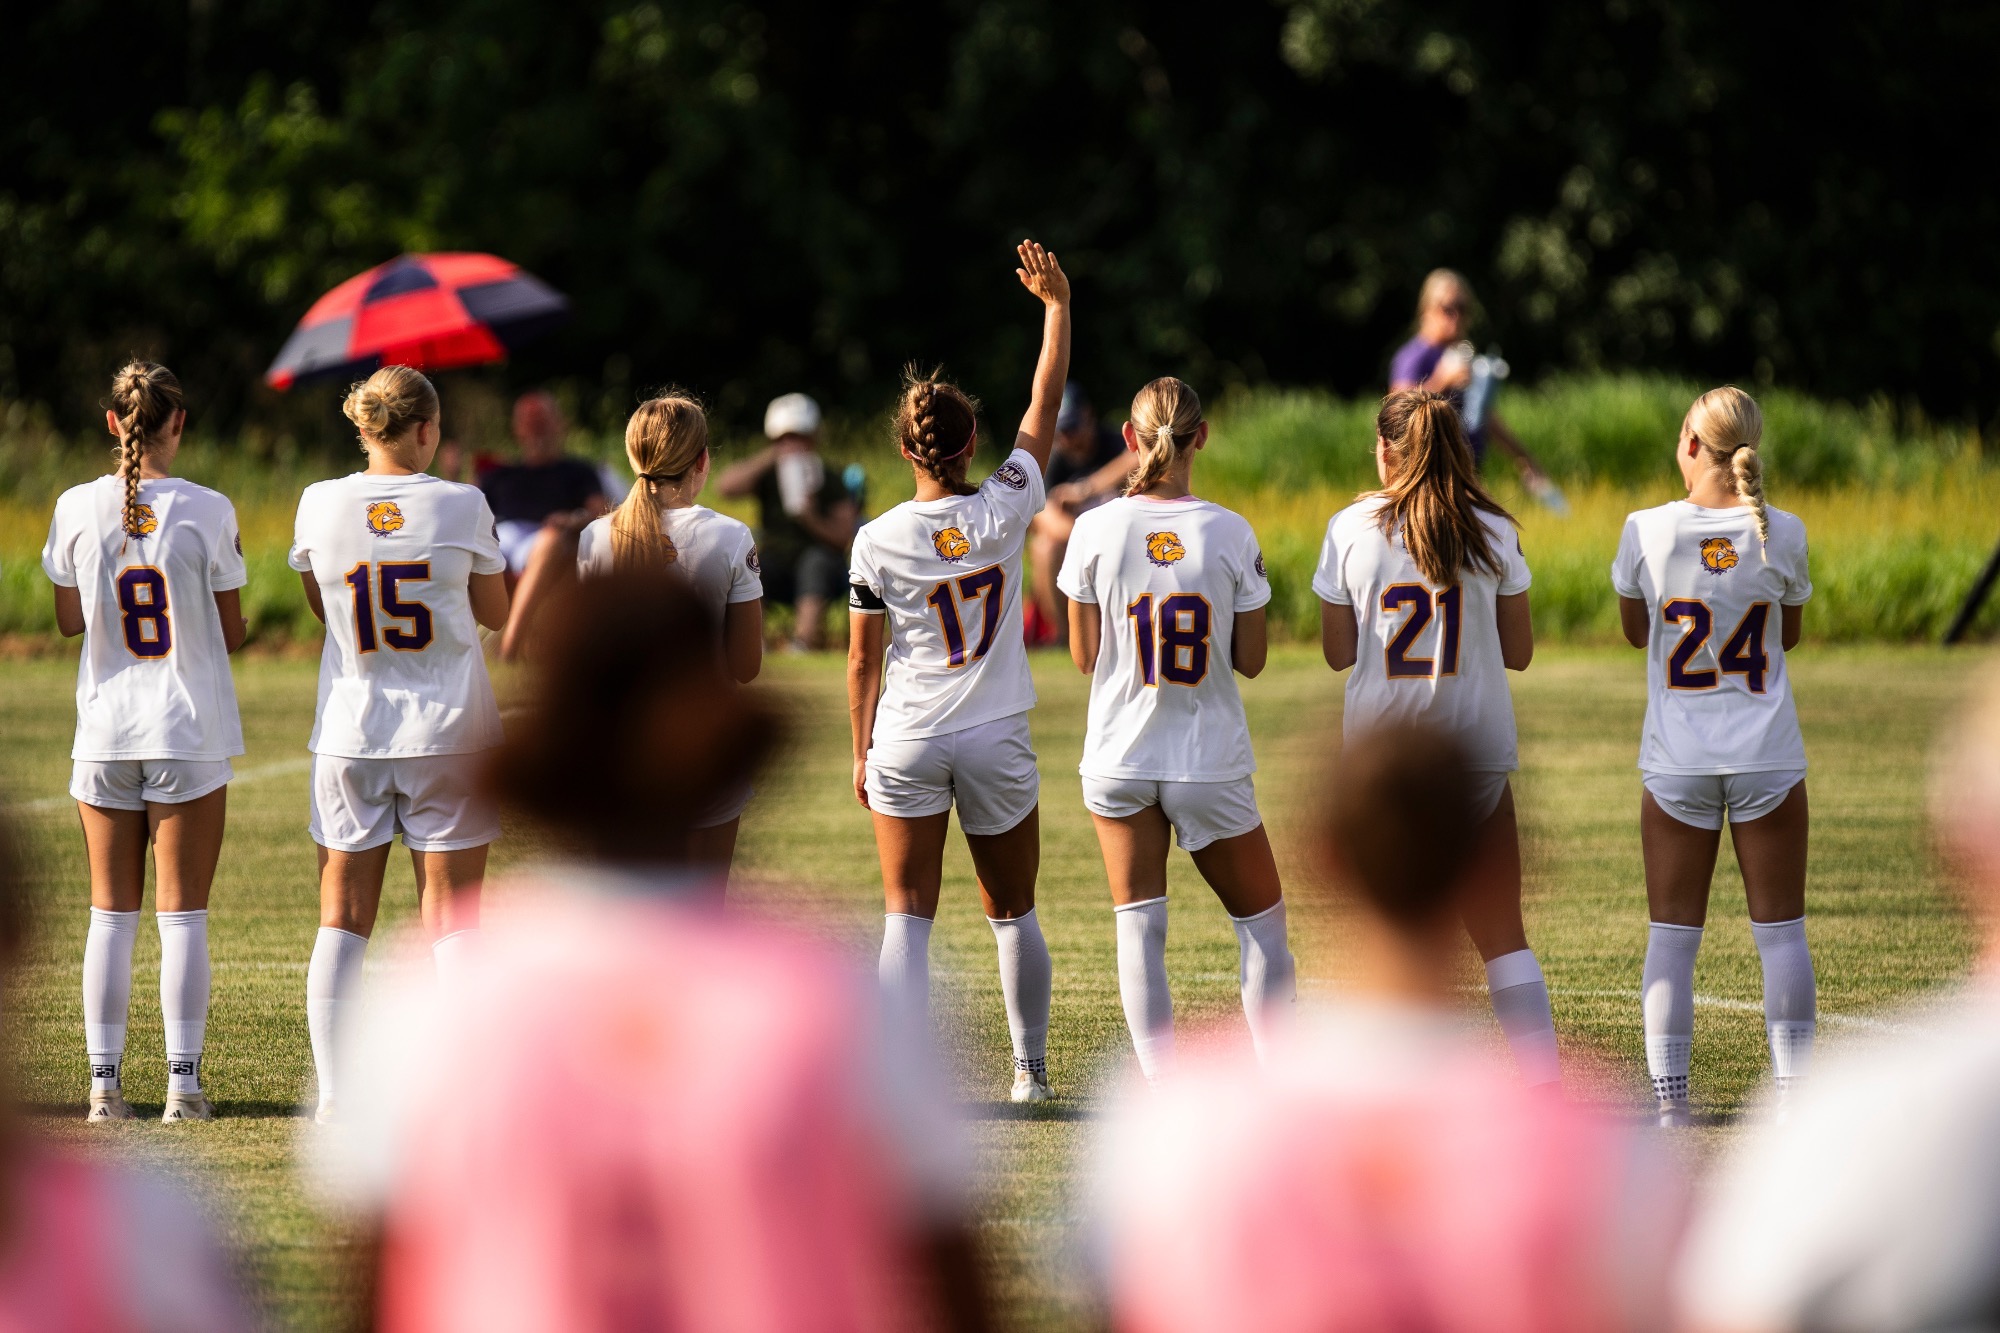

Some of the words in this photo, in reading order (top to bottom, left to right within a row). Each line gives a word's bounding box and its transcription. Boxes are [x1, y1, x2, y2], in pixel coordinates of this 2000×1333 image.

[116, 565, 172, 659] 8
[344, 561, 434, 654] 15
[926, 564, 1005, 668] 17
[1127, 592, 1211, 687] 18
[1381, 581, 1462, 679] 21
[1662, 598, 1771, 694] 24
